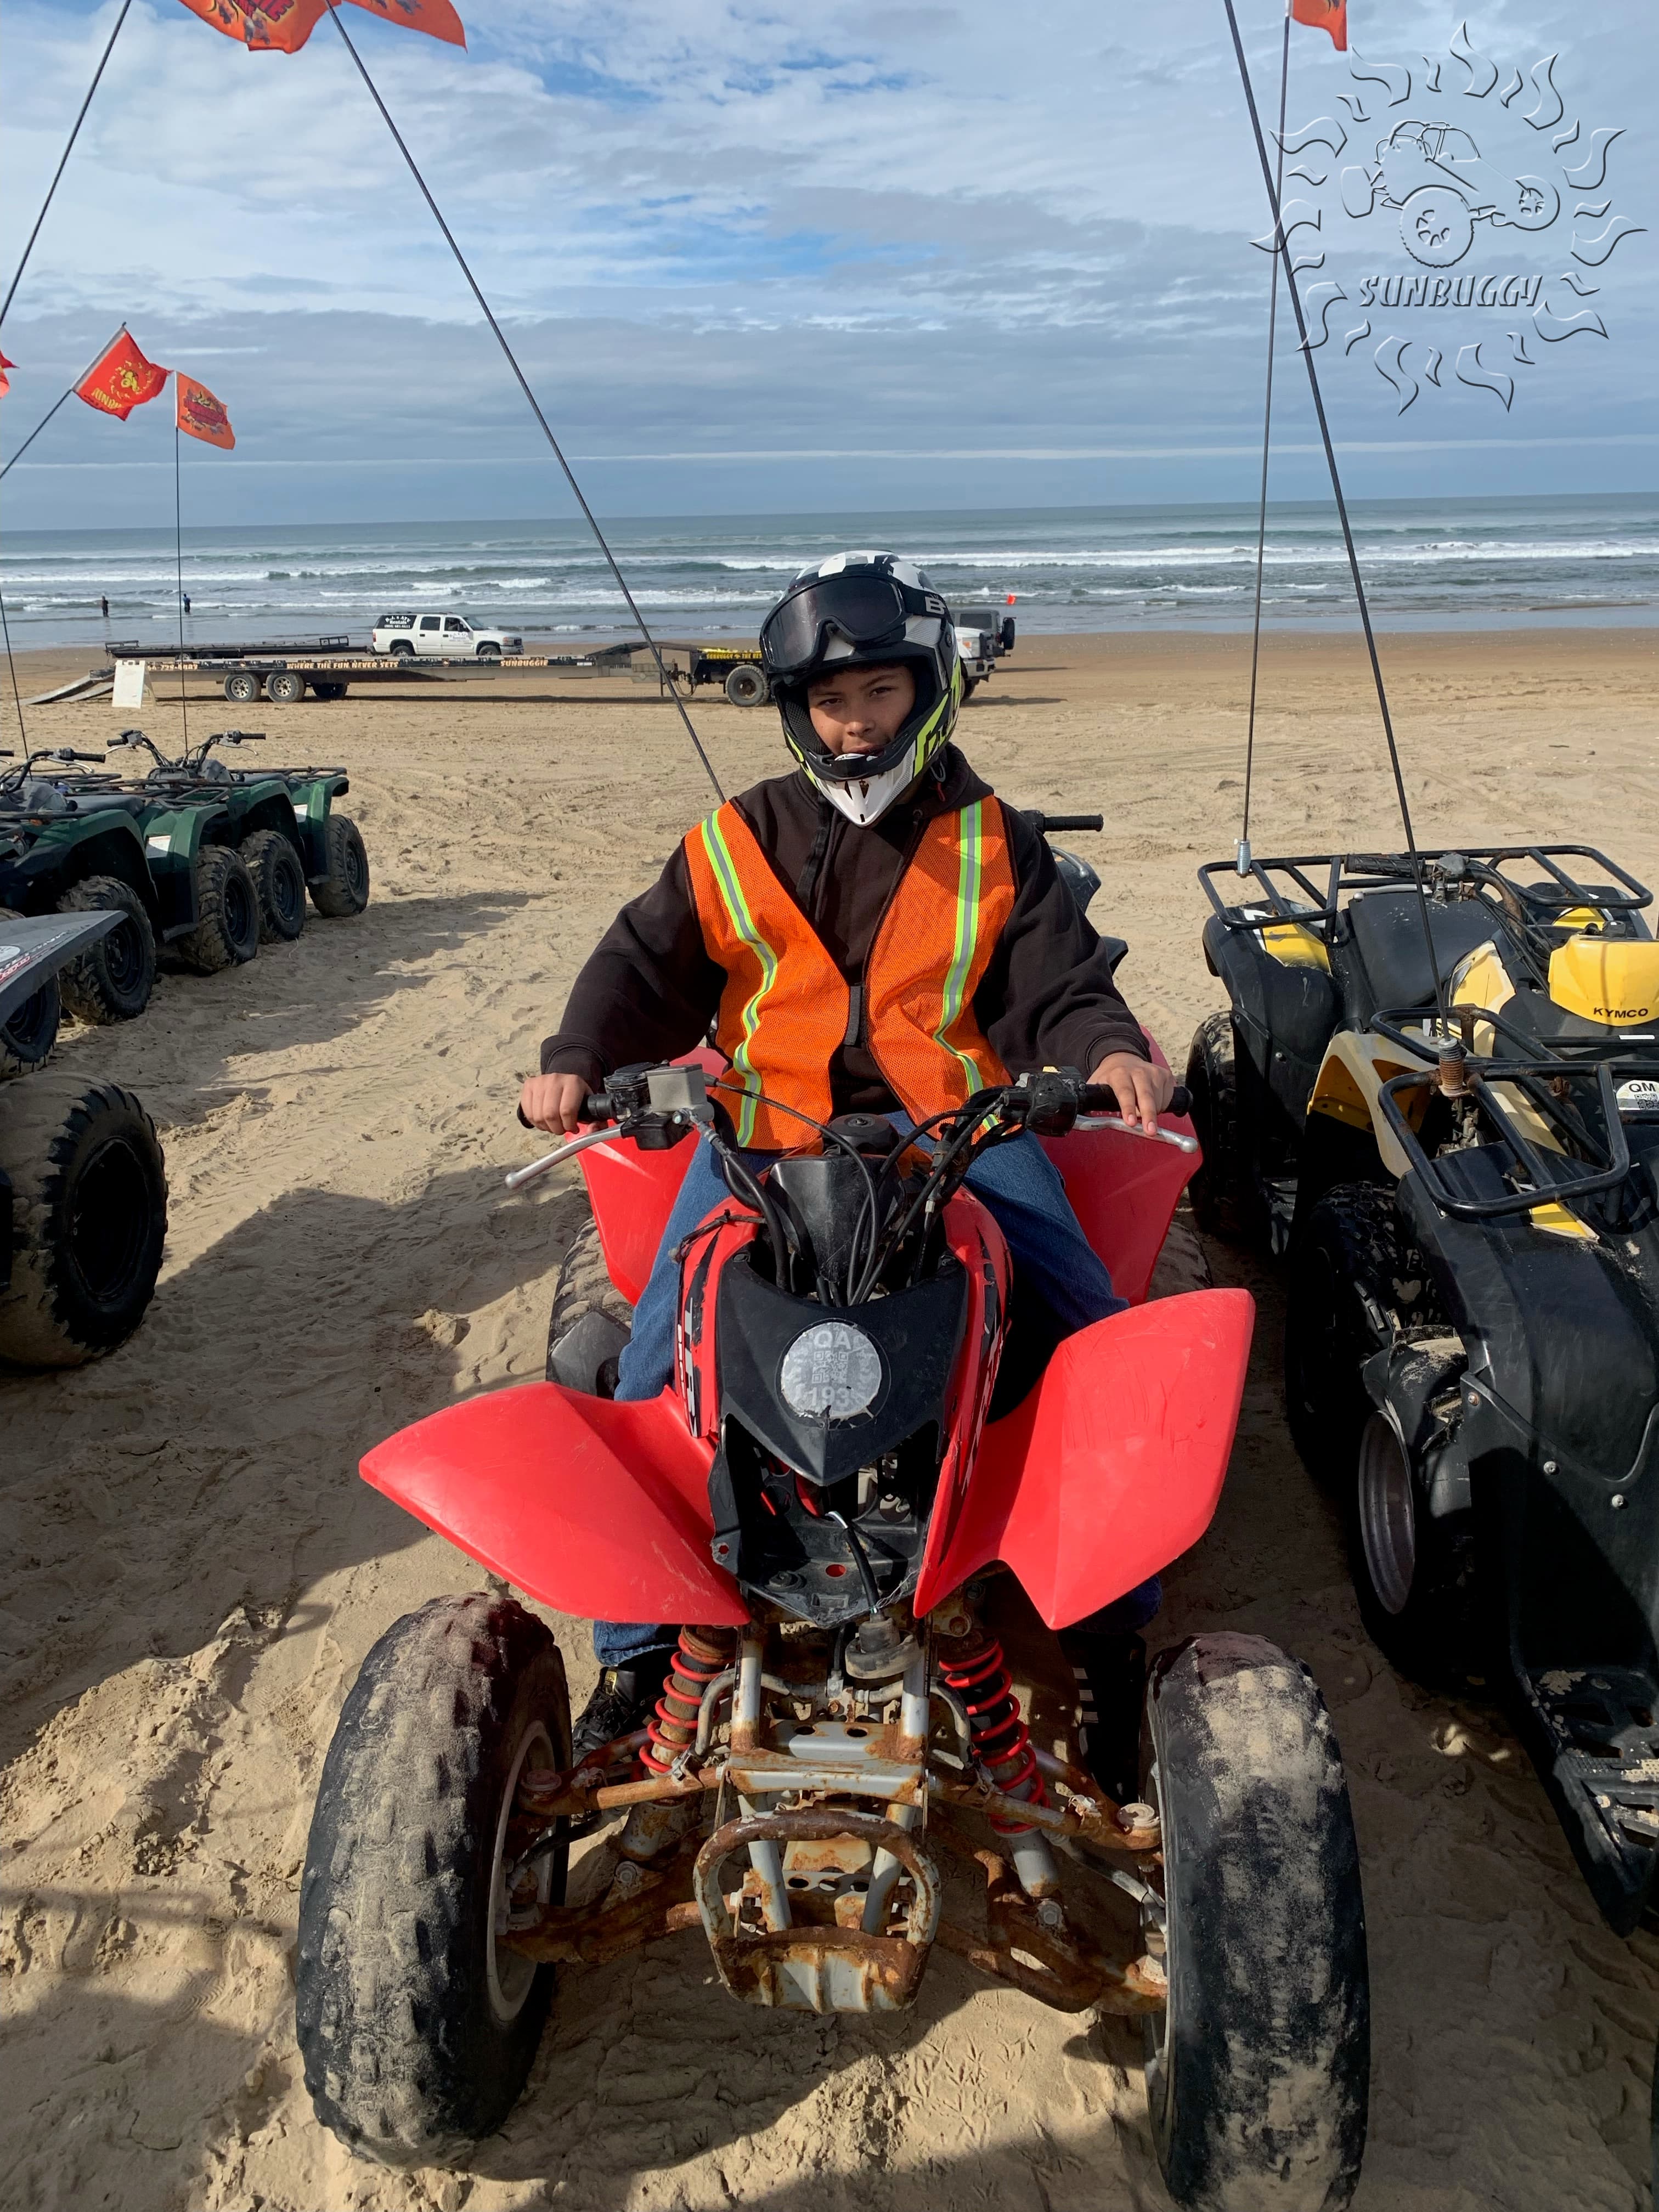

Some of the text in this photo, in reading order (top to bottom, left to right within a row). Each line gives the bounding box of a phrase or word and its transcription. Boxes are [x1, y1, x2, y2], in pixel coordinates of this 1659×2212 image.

[500, 659, 549, 667] SUNBUGGIE
[1593, 1007, 1649, 1018] KYMCO
[1628, 1082, 1656, 1092] QM
[814, 1329, 851, 1350] QA
[804, 1386, 850, 1407] 193
